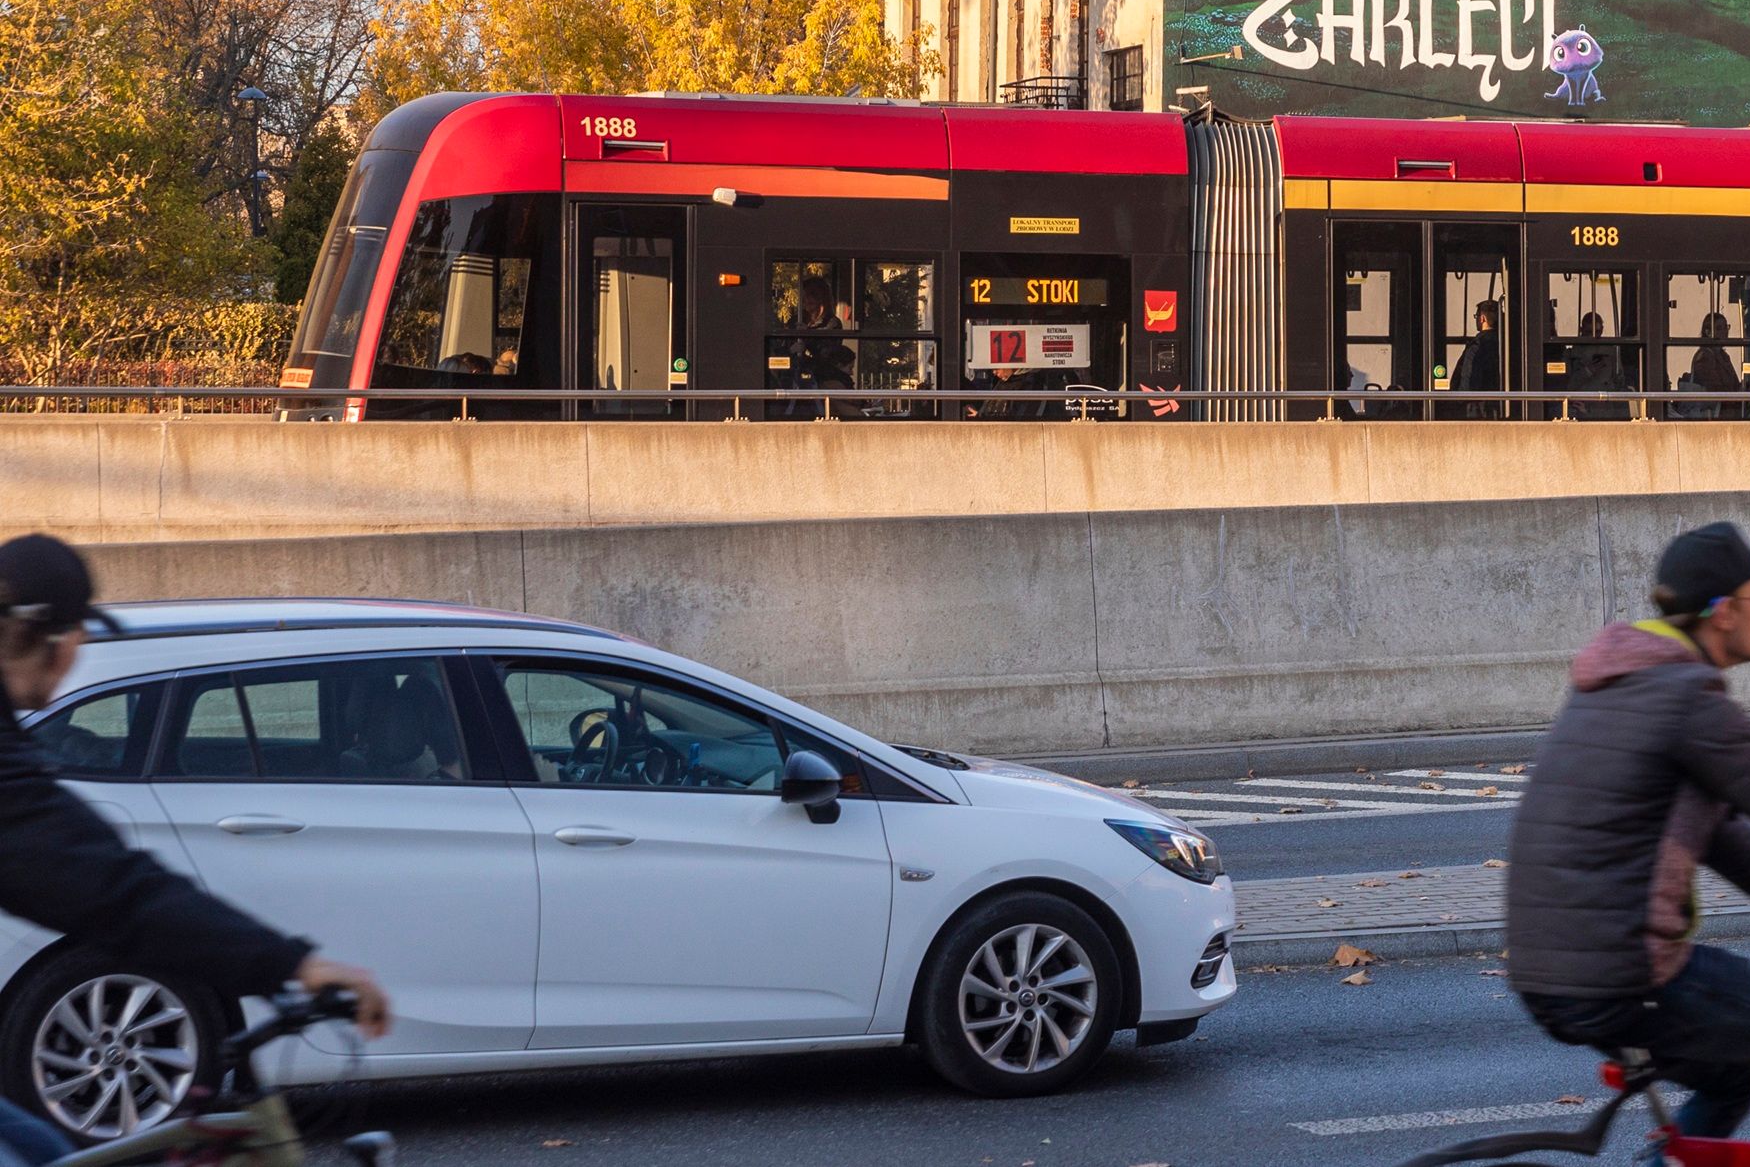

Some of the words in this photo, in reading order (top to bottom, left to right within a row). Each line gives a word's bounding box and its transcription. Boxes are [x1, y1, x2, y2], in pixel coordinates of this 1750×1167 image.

[580, 116, 637, 138] 1888
[1571, 226, 1619, 246] 1888
[970, 279, 991, 303] 12
[1027, 280, 1079, 303] STOKI
[993, 331, 1024, 363] 12
